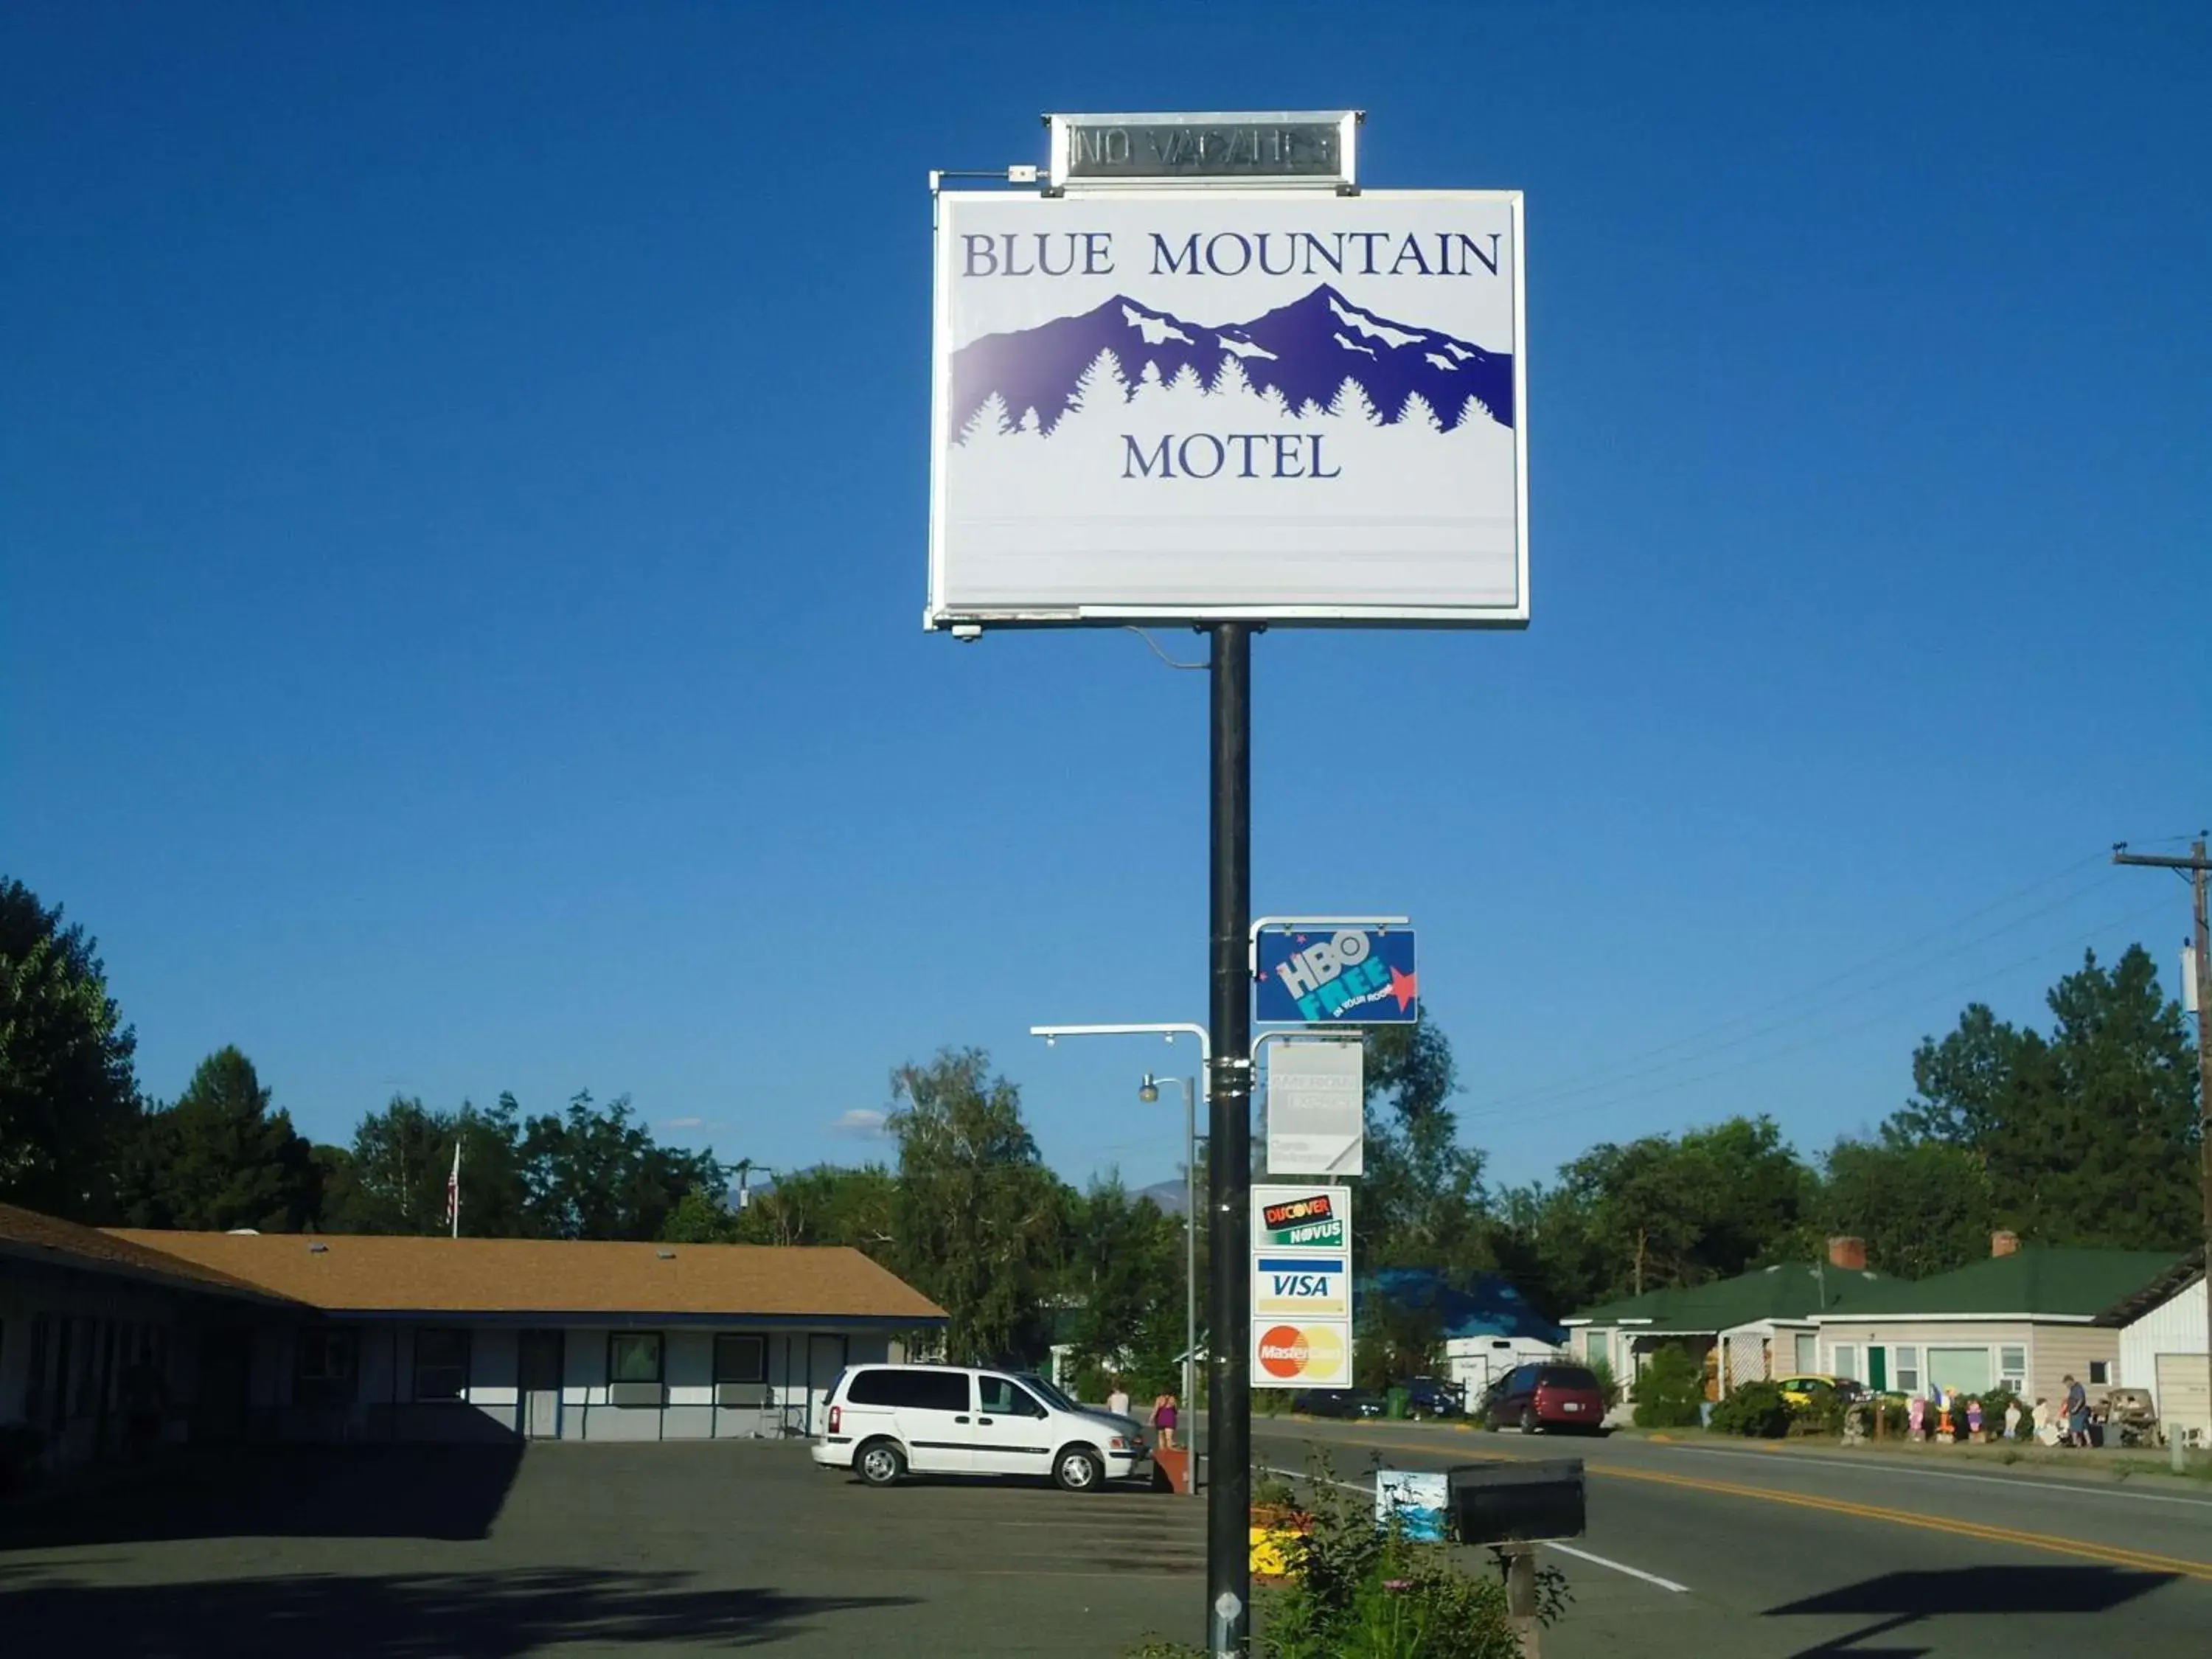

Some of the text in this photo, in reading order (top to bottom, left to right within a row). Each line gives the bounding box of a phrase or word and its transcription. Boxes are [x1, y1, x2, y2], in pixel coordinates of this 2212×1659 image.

[1077, 128, 1129, 163] NO
[961, 232, 1502, 276] BLUE MOUNTAIN
[1121, 433, 1342, 479] MOTEL
[1276, 930, 1369, 1000] HBO
[1297, 956, 1391, 1020] FREE
[1332, 1006, 1343, 1018] IN
[1342, 995, 1366, 1009] YOUR
[1267, 1198, 1329, 1222] DISCOVER
[1290, 1222, 1341, 1243] NOVUS
[1273, 1275, 1328, 1296] VISA
